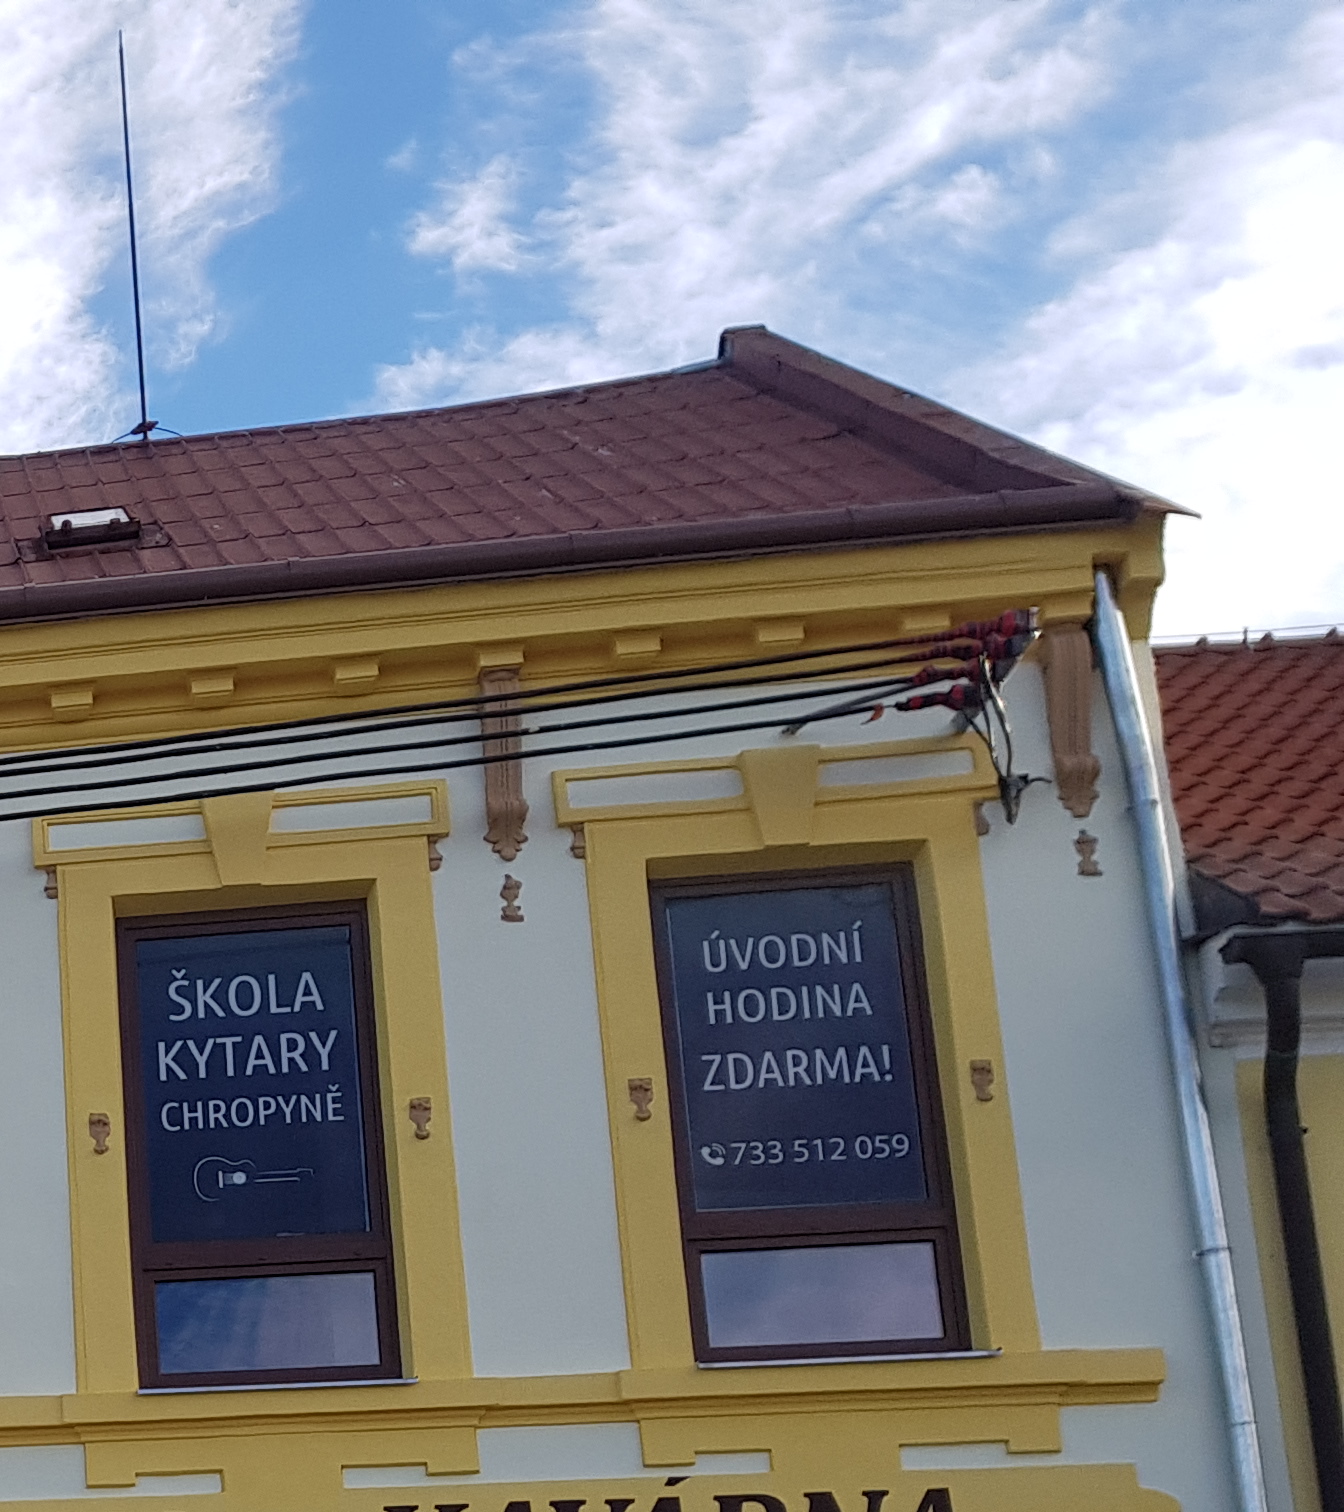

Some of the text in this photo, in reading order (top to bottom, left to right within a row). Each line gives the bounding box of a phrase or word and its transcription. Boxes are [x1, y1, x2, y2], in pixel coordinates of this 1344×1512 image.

[702, 920, 863, 973] ÚVODNÍ
[168, 968, 325, 1021] ŠKOLA
[706, 982, 873, 1025] HODINA
[157, 1029, 338, 1082] KYTARY
[701, 1044, 893, 1091] ZDARMA!
[161, 1083, 345, 1132] CHROPYNĚ
[730, 1133, 910, 1165] 733 512 059
